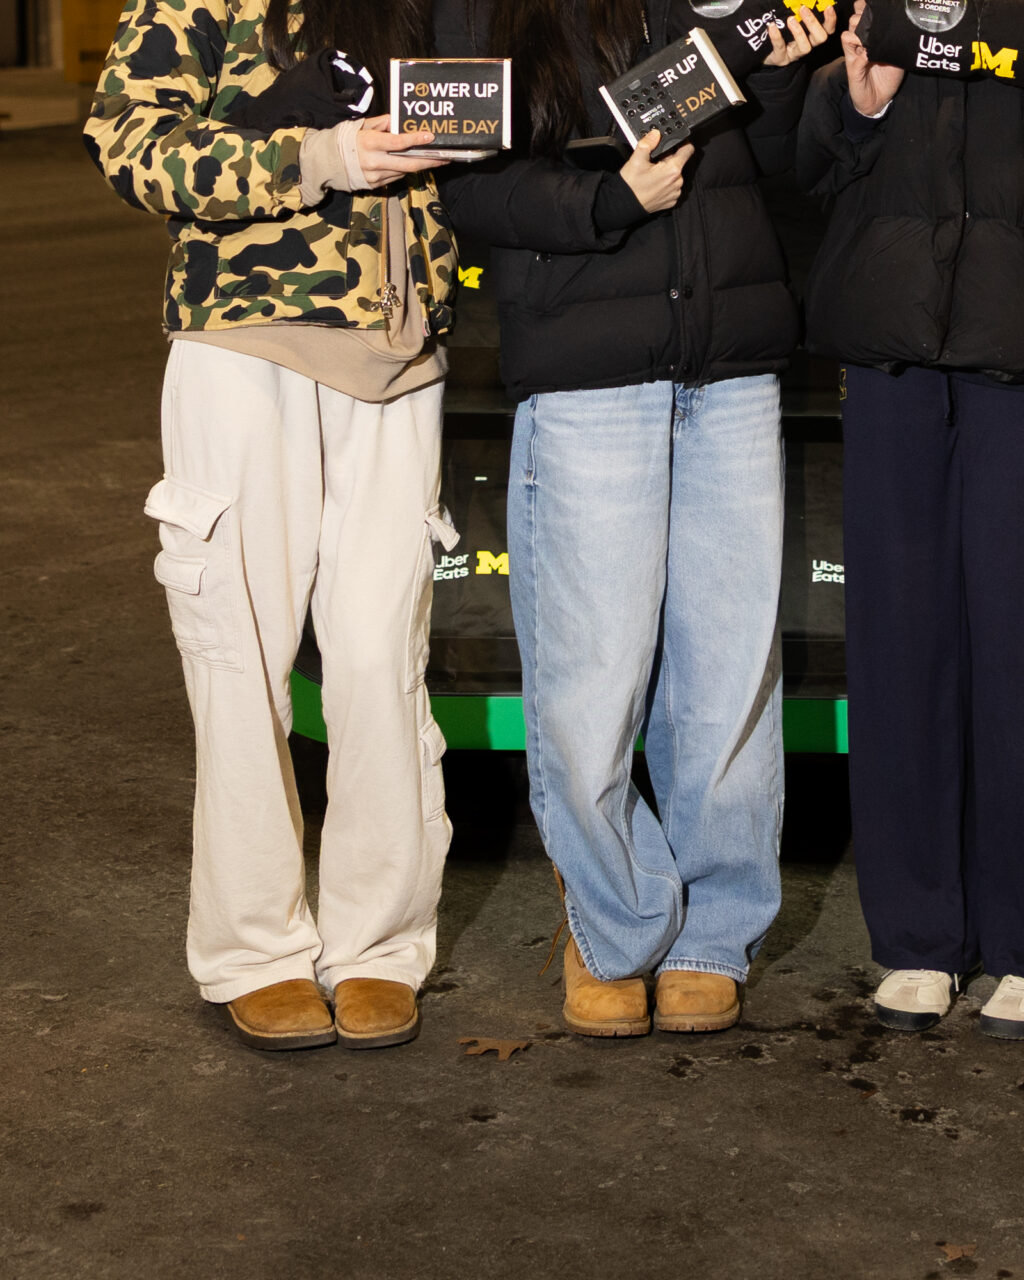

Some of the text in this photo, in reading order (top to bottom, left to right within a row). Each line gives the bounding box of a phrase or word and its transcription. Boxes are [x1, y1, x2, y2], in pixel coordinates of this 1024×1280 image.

[919, 35, 962, 57] Uber
[675, 52, 698, 75] UP
[916, 53, 960, 71] Eats
[970, 40, 1019, 79] M
[403, 82, 499, 98] POWER UP
[685, 82, 718, 113] DAY
[403, 101, 455, 116] YOUR
[403, 119, 499, 135] GAME DAY
[433, 566, 470, 581] Eats
[812, 559, 845, 573] Ube
